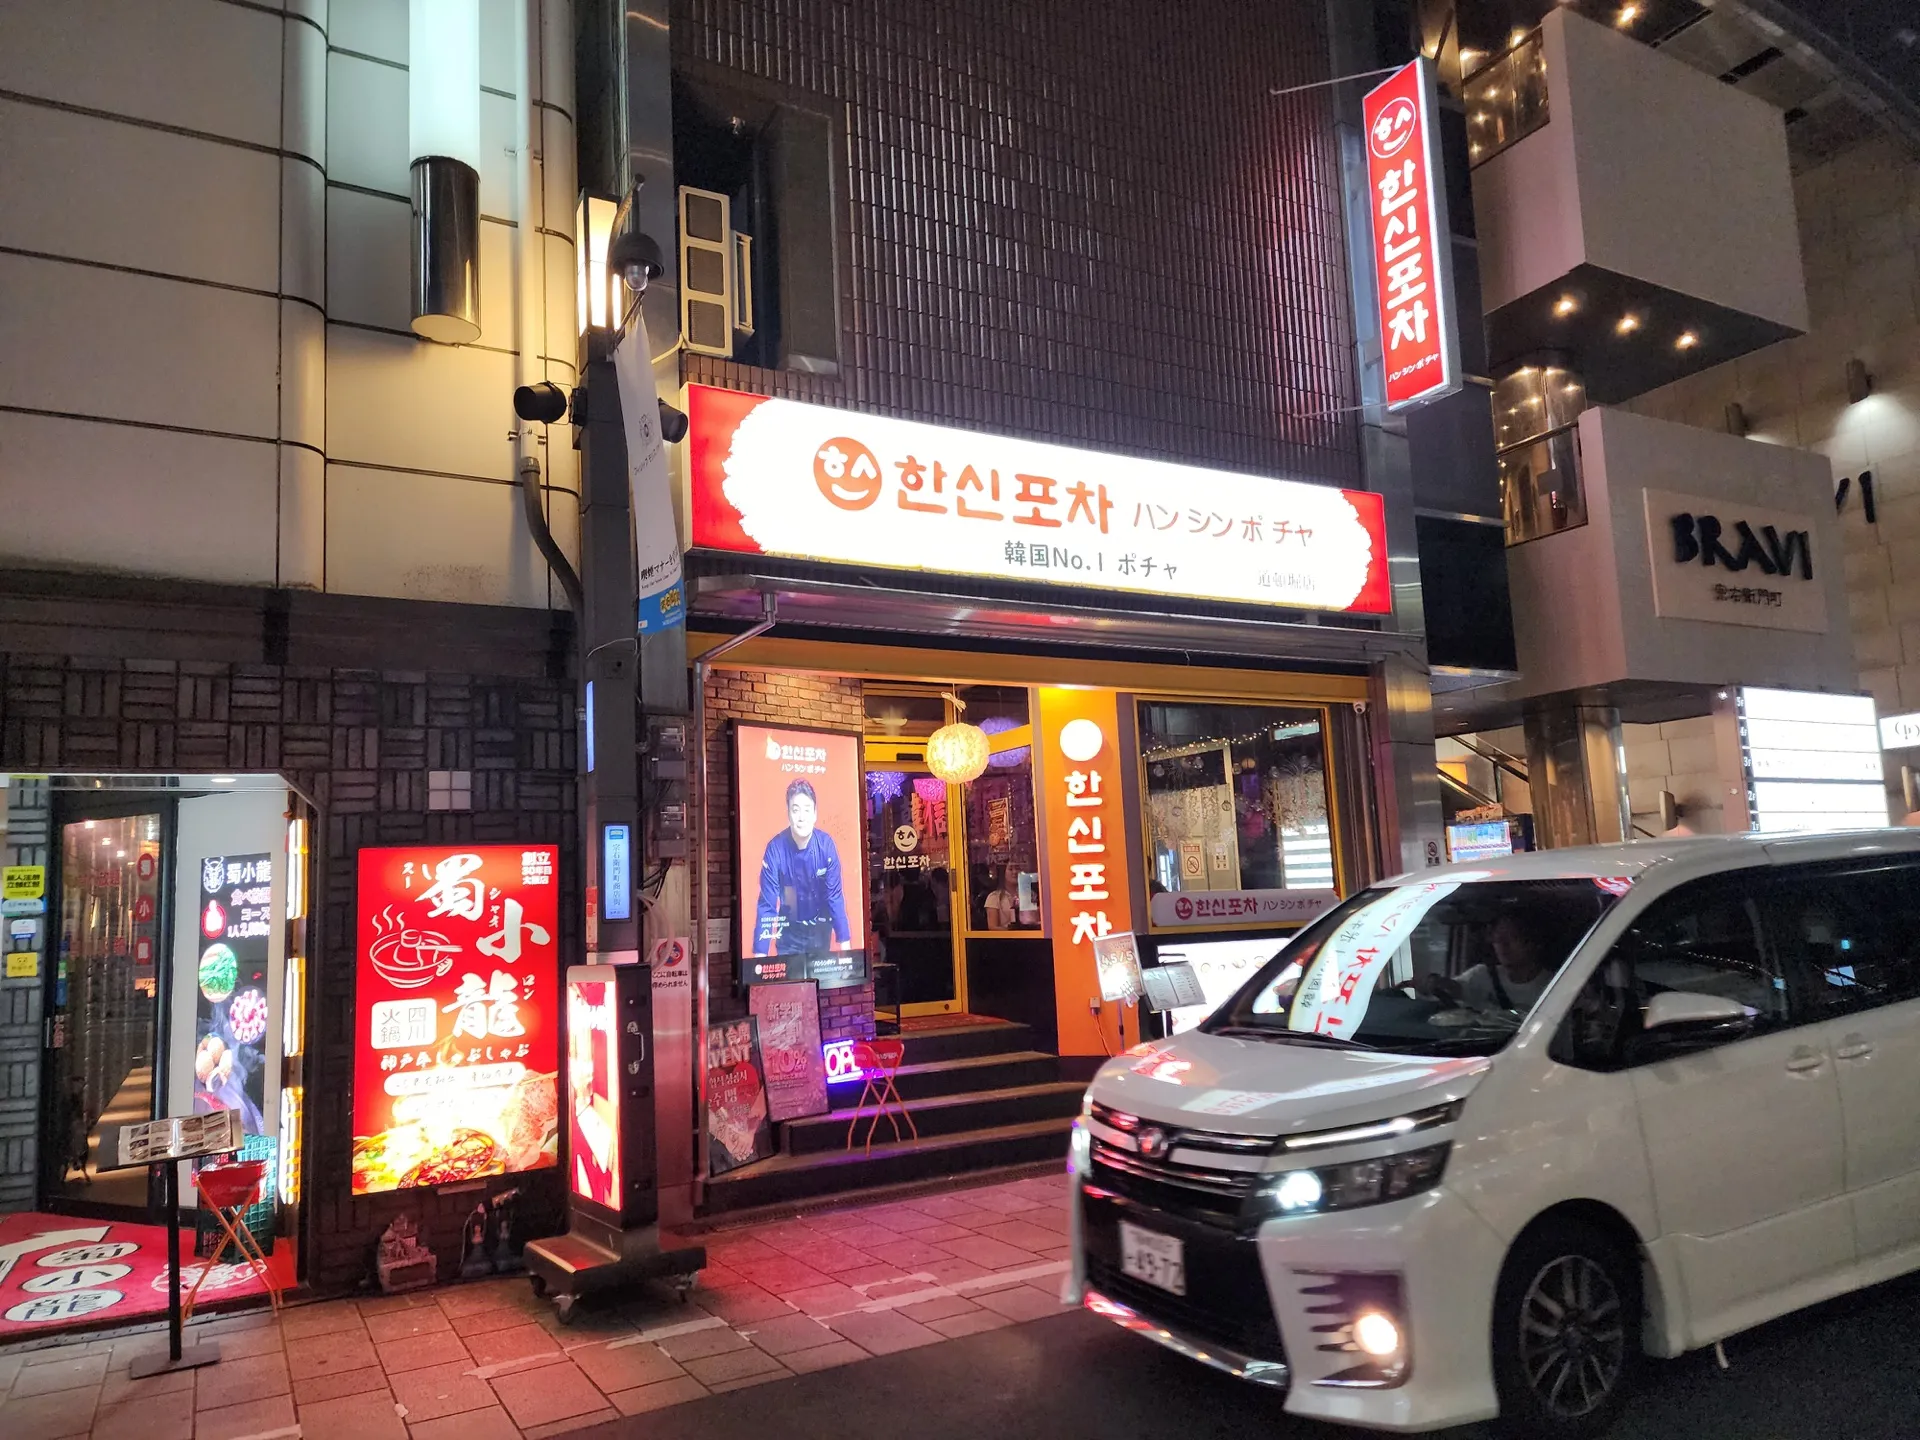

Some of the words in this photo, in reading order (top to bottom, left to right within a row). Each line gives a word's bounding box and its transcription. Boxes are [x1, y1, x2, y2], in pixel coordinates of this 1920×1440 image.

[1378, 158, 1429, 350] 한신포차
[1388, 352, 1440, 383] ハンシンポチャ
[894, 454, 1114, 534] 한신포차
[1133, 502, 1313, 547] ハンシンポチャ
[1004, 540, 1102, 572] 韓国No.1
[1118, 553, 1178, 580] ポチャ
[1670, 512, 1813, 580] BRAVI
[226, 860, 271, 884] 蜀小龍
[883, 855, 931, 870] 한신포차
[1063, 769, 1113, 945] 한신포차
[240, 906, 271, 921] コース
[1195, 897, 1258, 917] 한신포차
[1262, 899, 1322, 911] ハンシンポチャ
